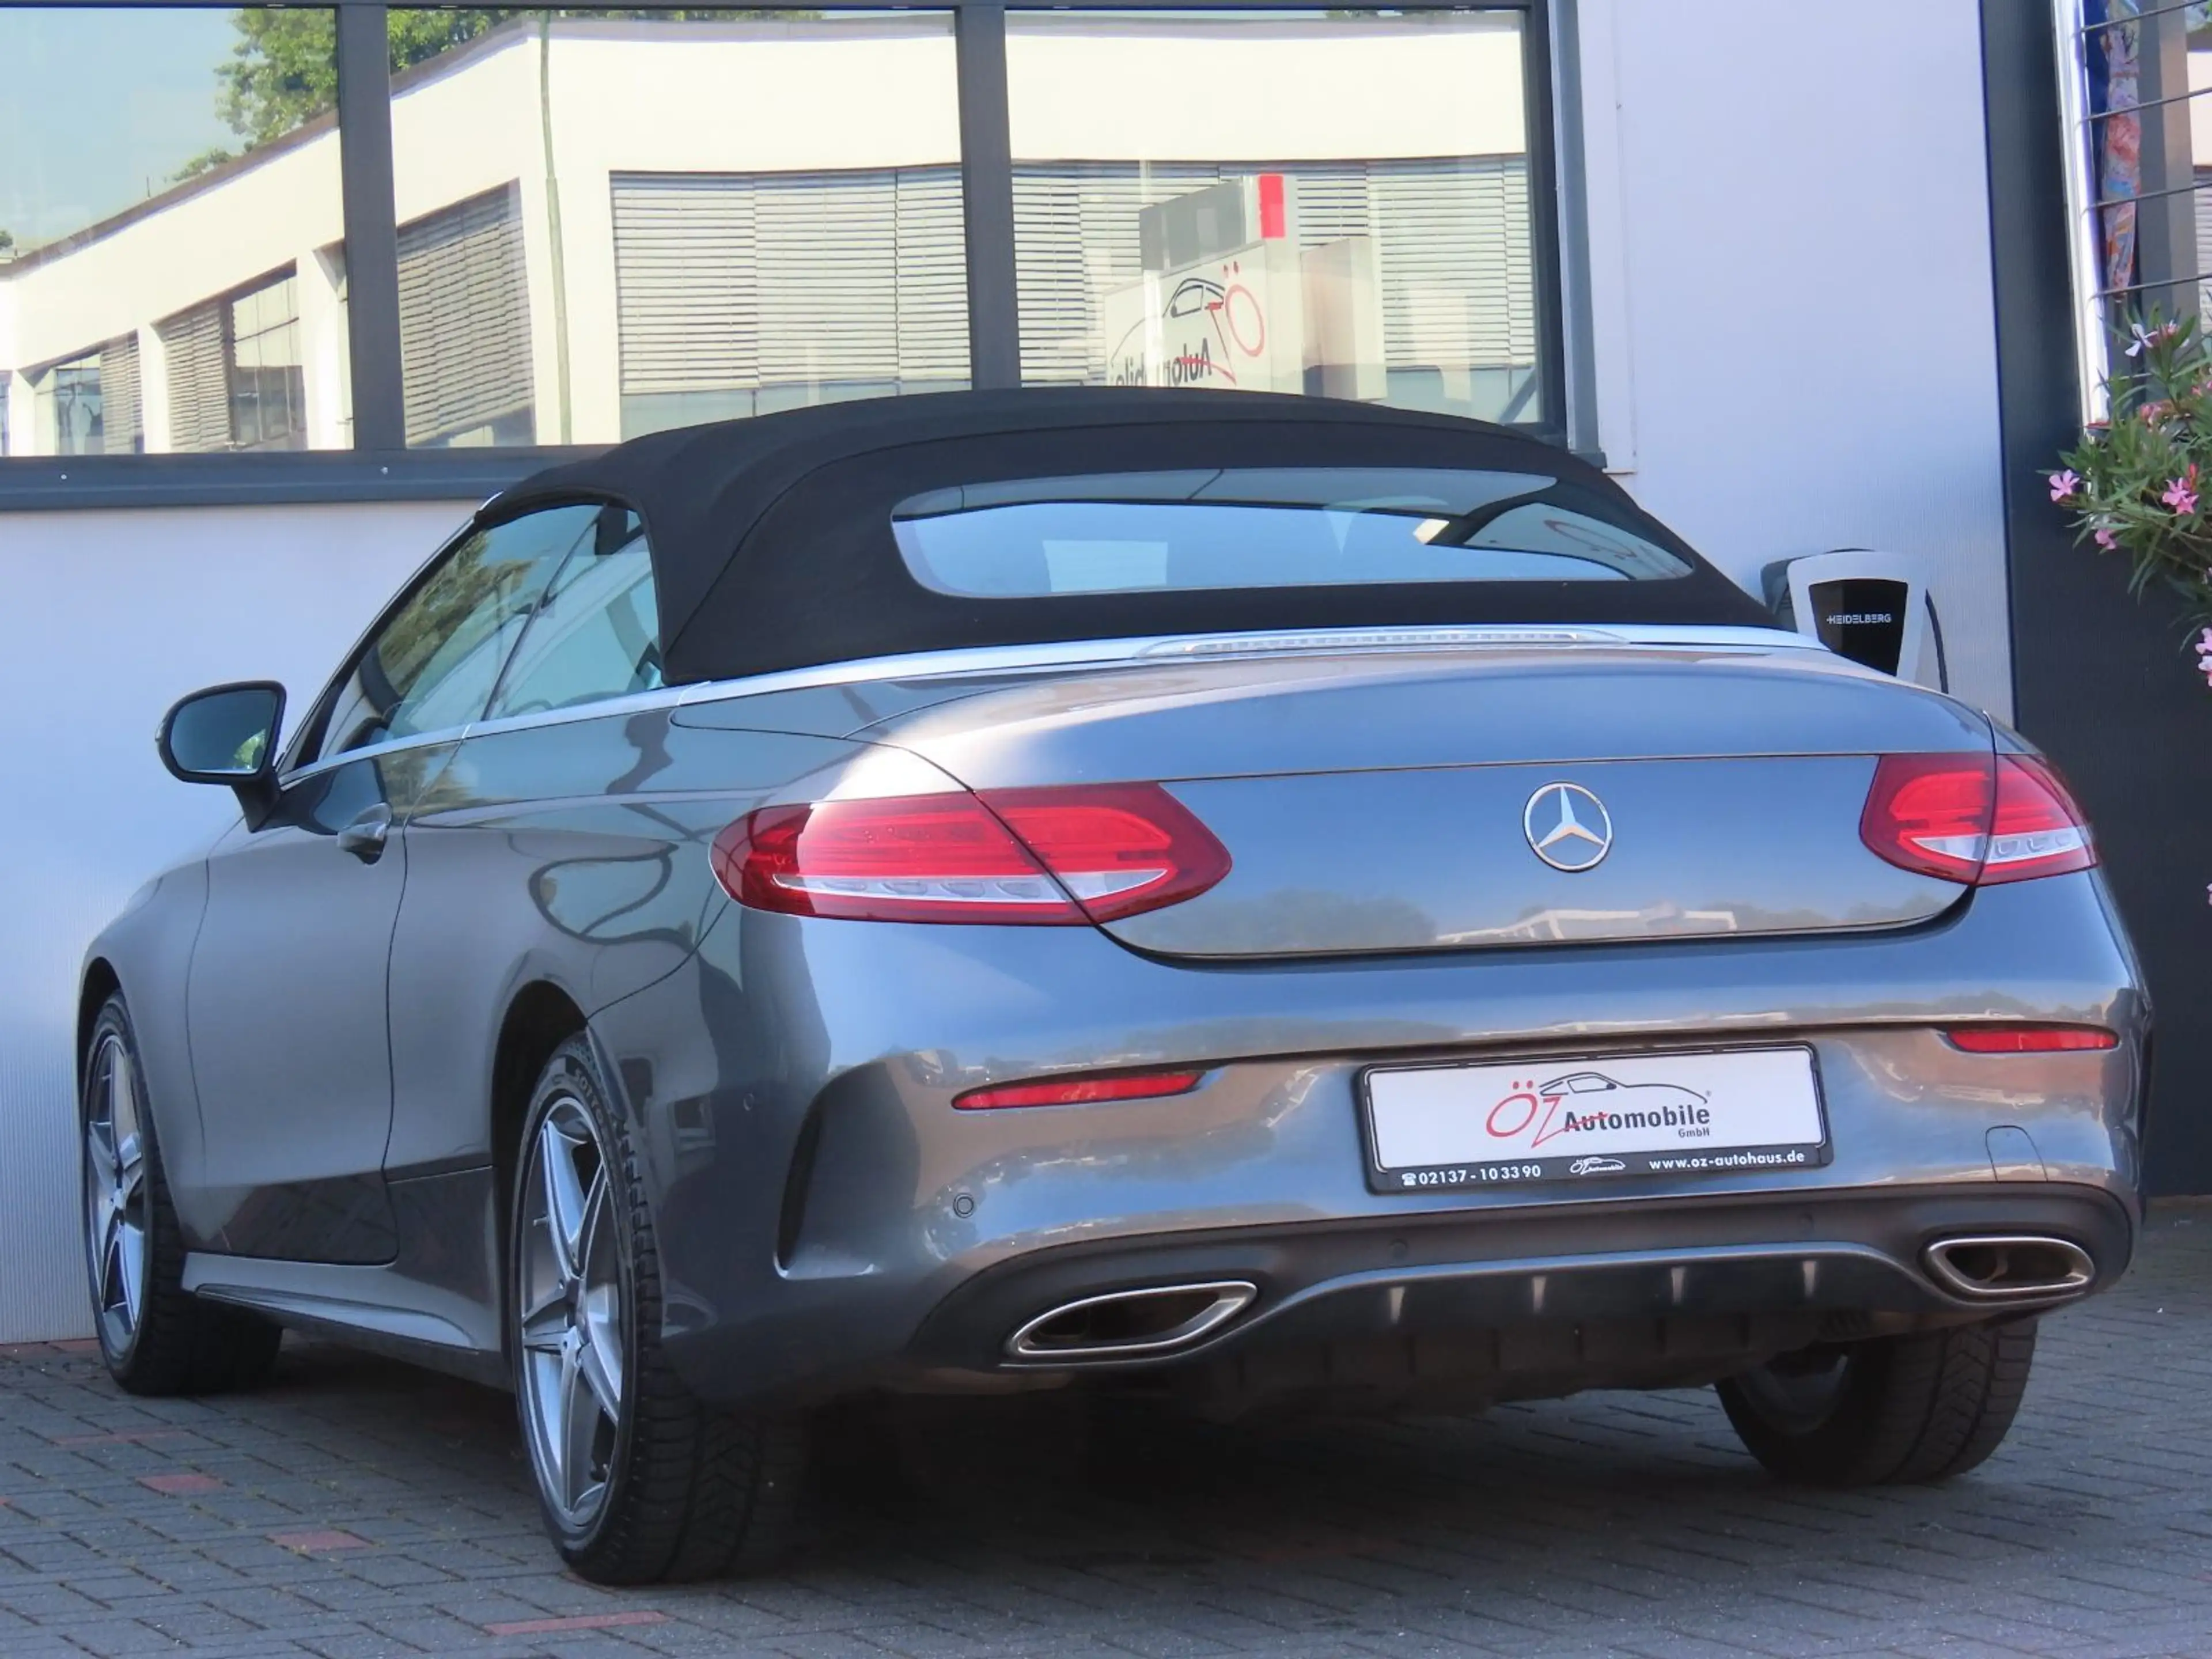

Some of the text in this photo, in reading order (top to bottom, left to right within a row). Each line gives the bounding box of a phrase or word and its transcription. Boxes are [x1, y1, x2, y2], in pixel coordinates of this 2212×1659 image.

[1827, 613, 1891, 624] HEIDELBERG
[1486, 1080, 1710, 1149] ÖZ Automobile
[1679, 1127, 1710, 1138] GmbH
[1649, 1150, 1805, 1169] www.oz-autohaus.de
[1418, 1169, 1467, 1185] 02137
